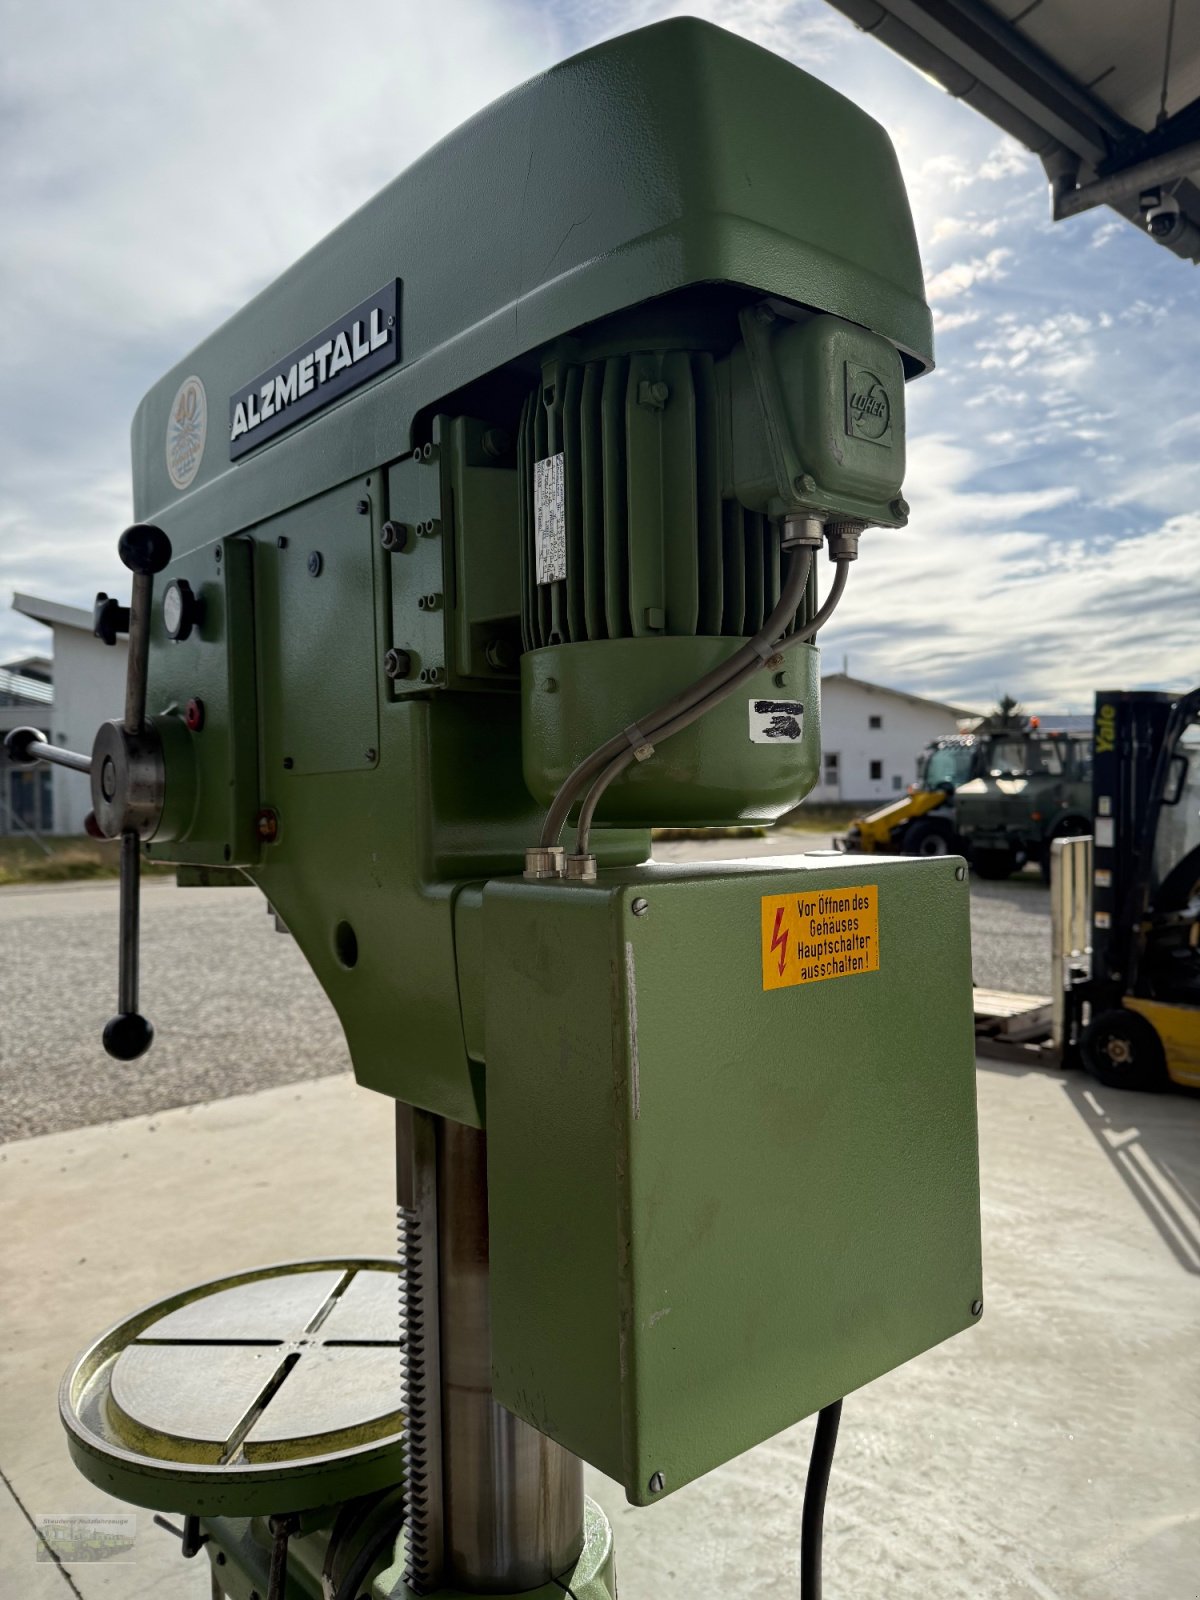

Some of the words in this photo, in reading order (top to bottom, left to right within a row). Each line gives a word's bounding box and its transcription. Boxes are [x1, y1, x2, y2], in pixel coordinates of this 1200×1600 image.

[230, 307, 389, 441] ALZMETALL
[850, 393, 886, 418] LOHER
[1096, 703, 1116, 754] Yale
[797, 900, 816, 918] Vor
[818, 893, 850, 915] Öffnen
[852, 893, 869, 911] des
[810, 916, 859, 937] Gehäuses
[797, 933, 871, 961] Hauptschalter
